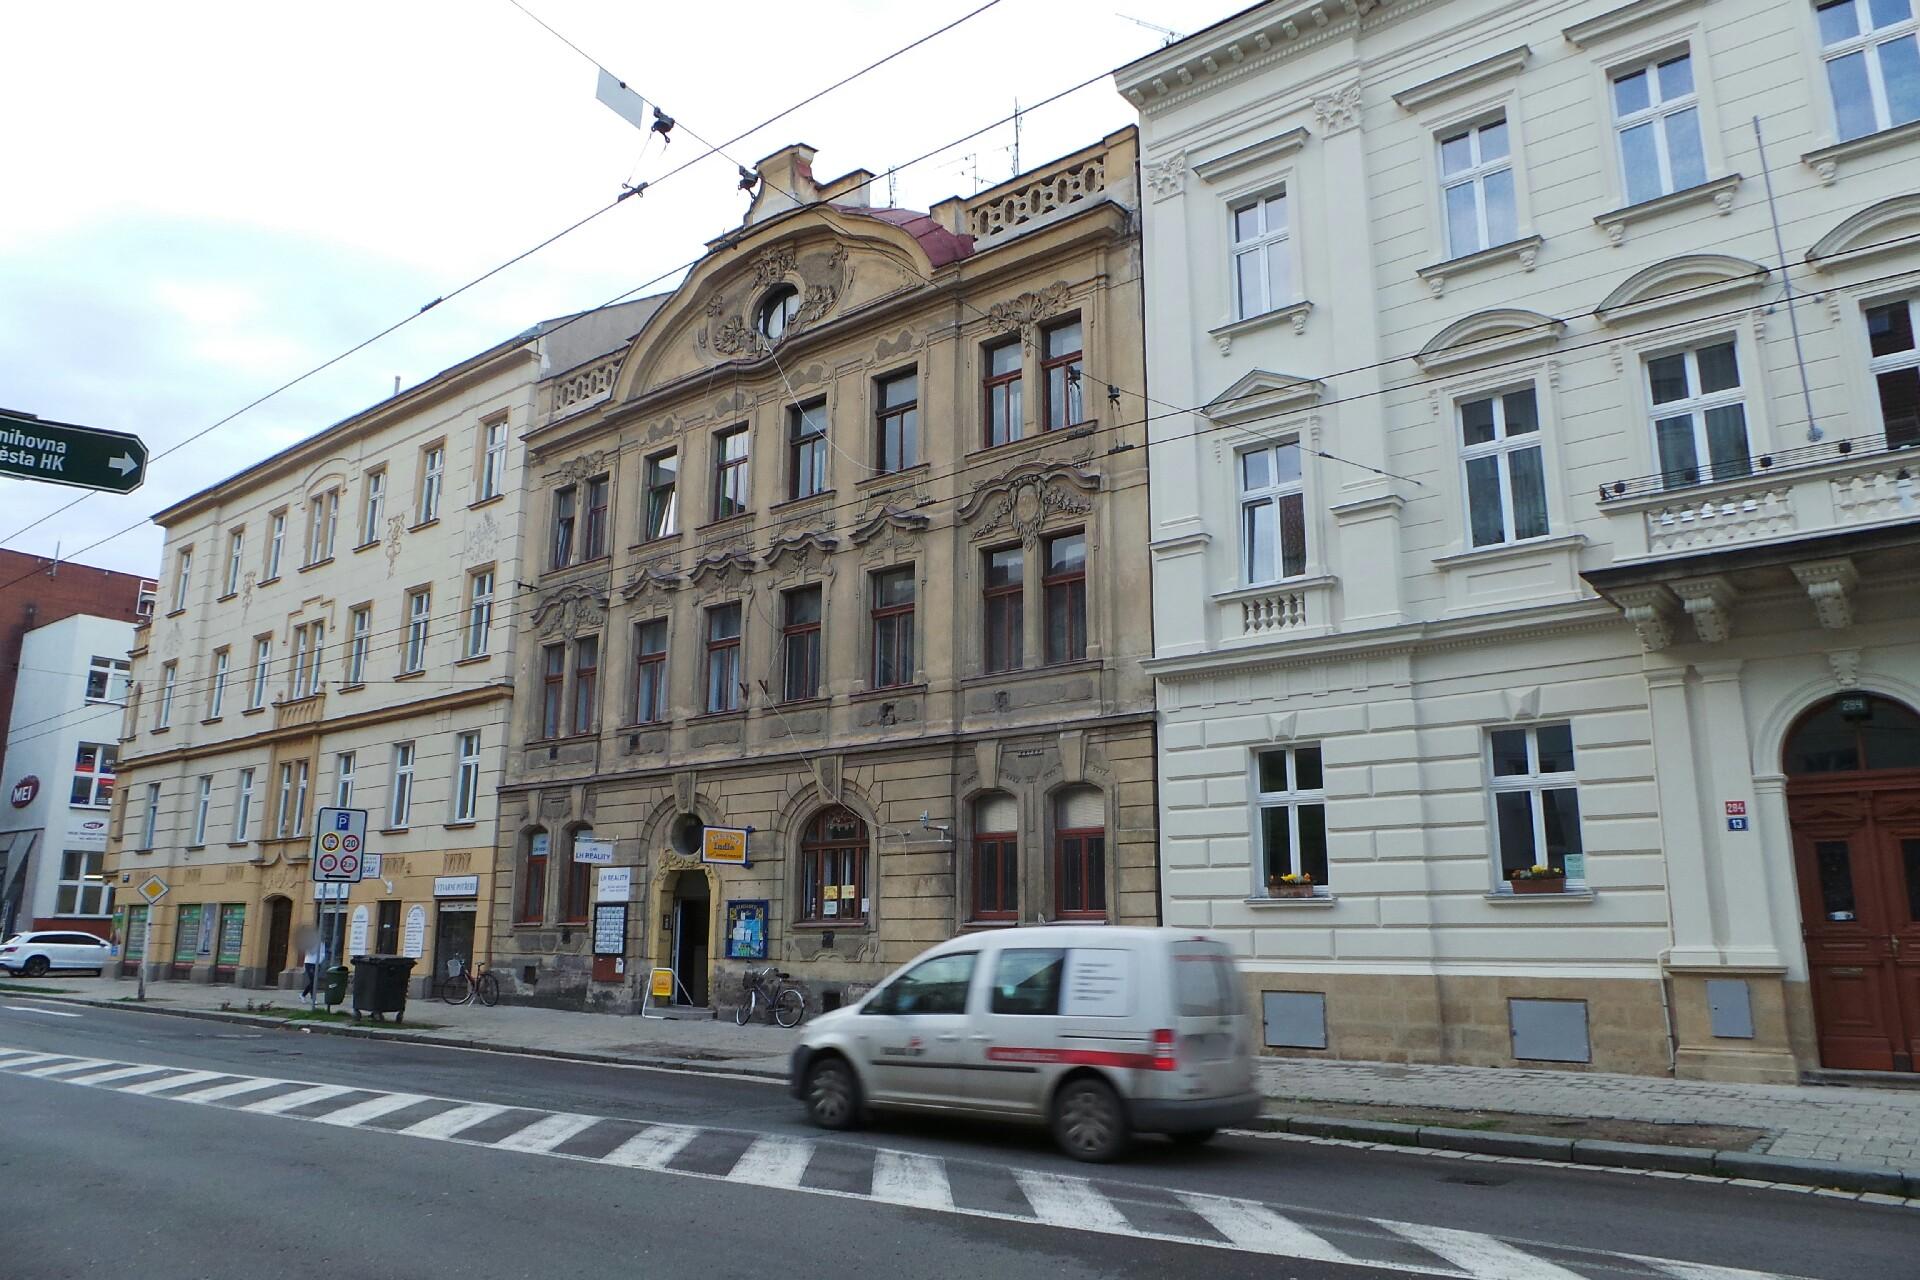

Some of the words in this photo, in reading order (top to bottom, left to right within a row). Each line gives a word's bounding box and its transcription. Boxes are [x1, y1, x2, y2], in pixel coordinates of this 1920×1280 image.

[40, 453, 65, 471] HK
[12, 786, 33, 802] MEI
[1727, 803, 1744, 813] 284
[338, 817, 347, 828] P
[1732, 819, 1742, 828] 13
[346, 840, 356, 848] 20
